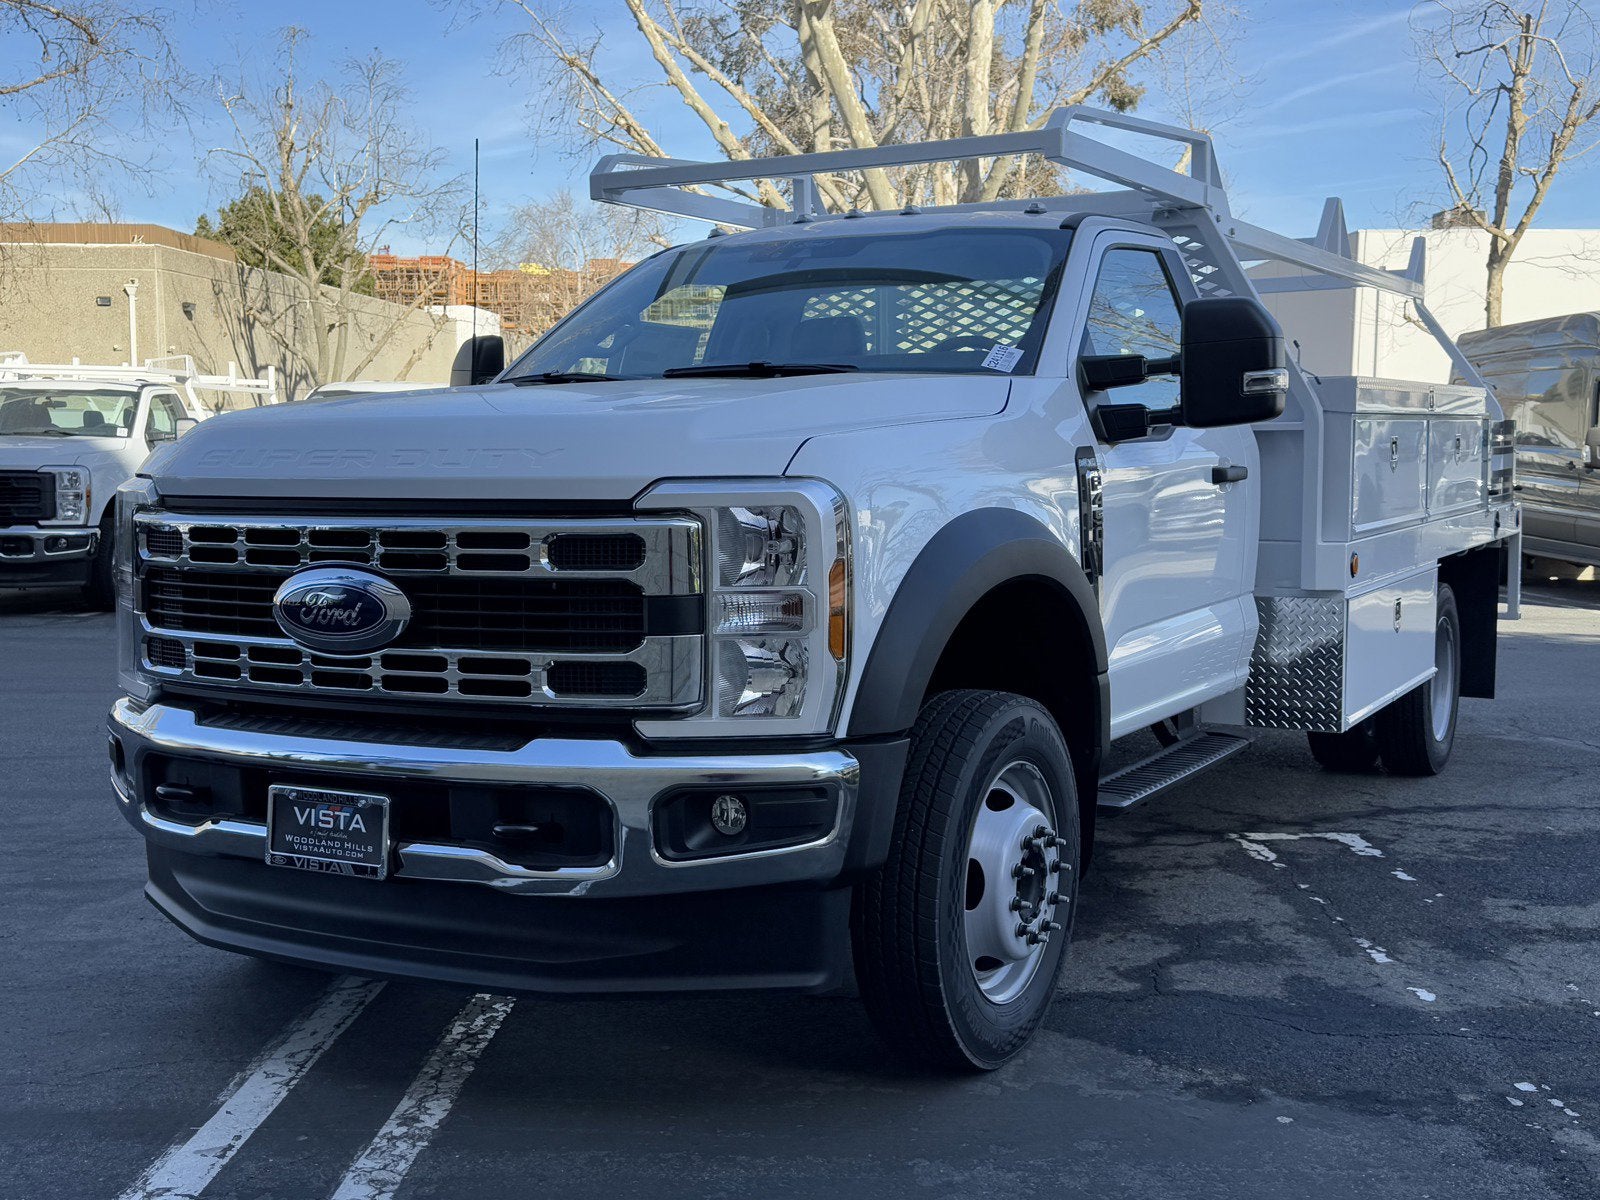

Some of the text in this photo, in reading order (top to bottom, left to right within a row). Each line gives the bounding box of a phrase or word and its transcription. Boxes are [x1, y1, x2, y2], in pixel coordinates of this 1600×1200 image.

[198, 447, 565, 469] SUPER DUTY
[300, 591, 363, 626] Ford
[293, 806, 367, 833] VISTA
[285, 834, 341, 848] WOODLAND
[344, 842, 374, 853] HILLS
[293, 856, 342, 873] VISTA
